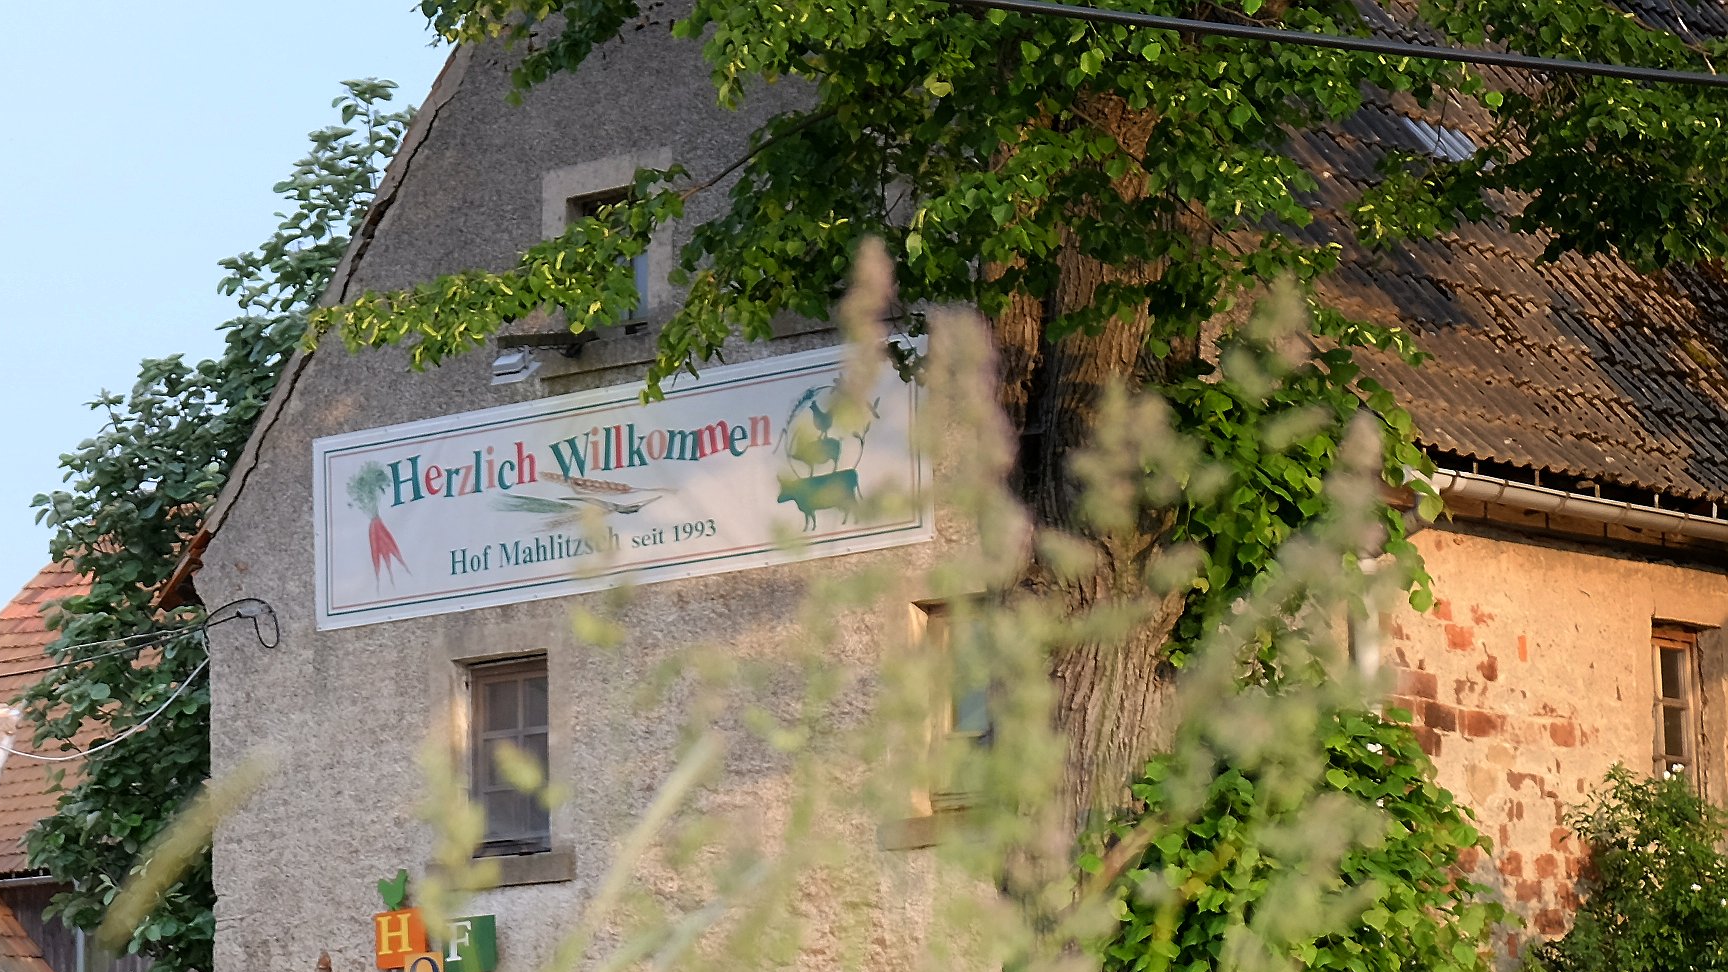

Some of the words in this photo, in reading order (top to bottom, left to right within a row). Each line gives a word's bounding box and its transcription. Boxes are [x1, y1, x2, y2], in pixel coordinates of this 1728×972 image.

[387, 441, 538, 508] Herzlich
[549, 414, 772, 480] Willkommen
[450, 545, 491, 576] Hof
[499, 527, 621, 568] Mahlitzsch
[631, 527, 664, 549] seit
[672, 518, 717, 543] 1993
